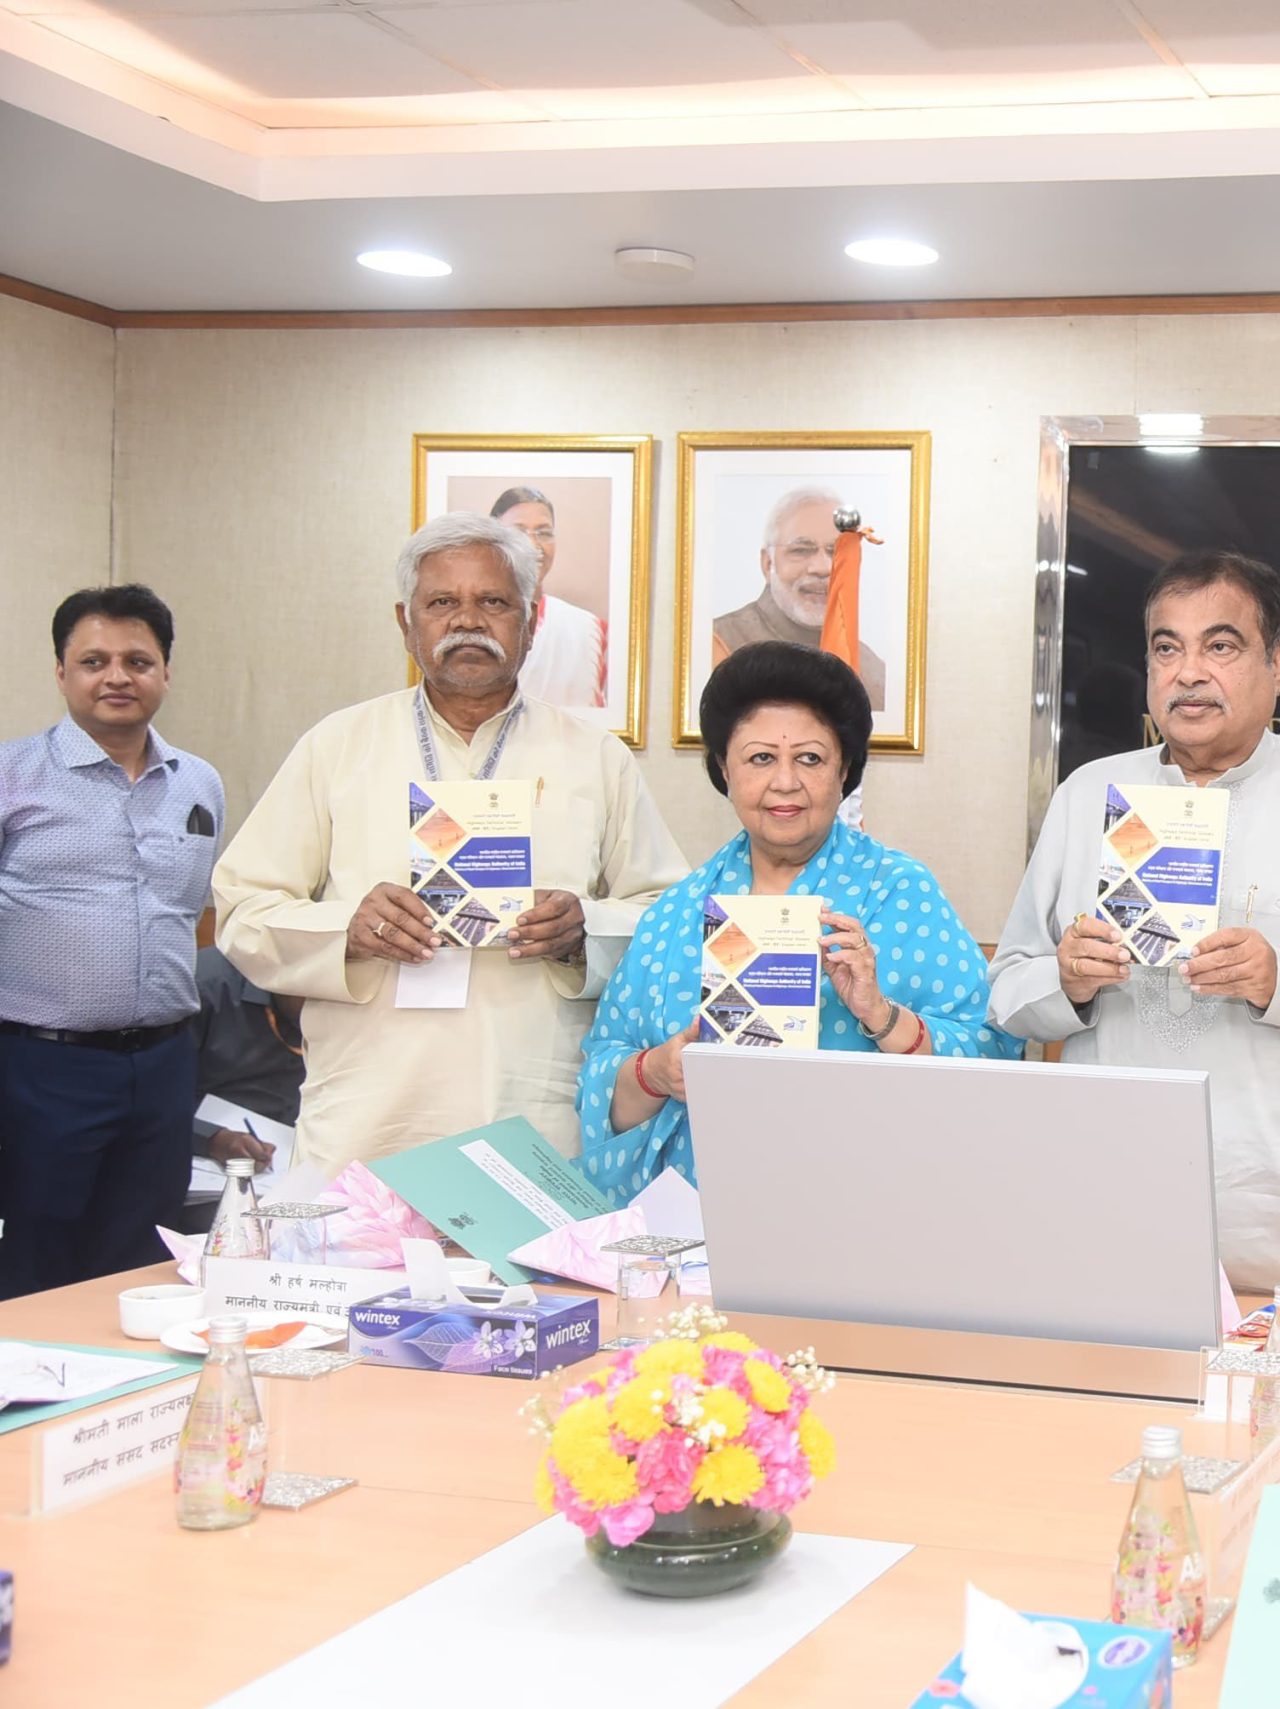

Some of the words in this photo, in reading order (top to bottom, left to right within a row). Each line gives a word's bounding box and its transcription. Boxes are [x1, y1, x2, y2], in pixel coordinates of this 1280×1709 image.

[269, 1272, 282, 1288] श्री
[287, 1274, 304, 1290] हर्ष
[309, 1277, 348, 1294] मल्होत्रा
[225, 1294, 268, 1310] माननीय
[355, 1309, 401, 1325] wintex
[546, 1319, 592, 1350] wintex
[73, 1418, 109, 1445] श्रीमती
[117, 1410, 144, 1430] माला
[63, 1457, 109, 1487] माननीय
